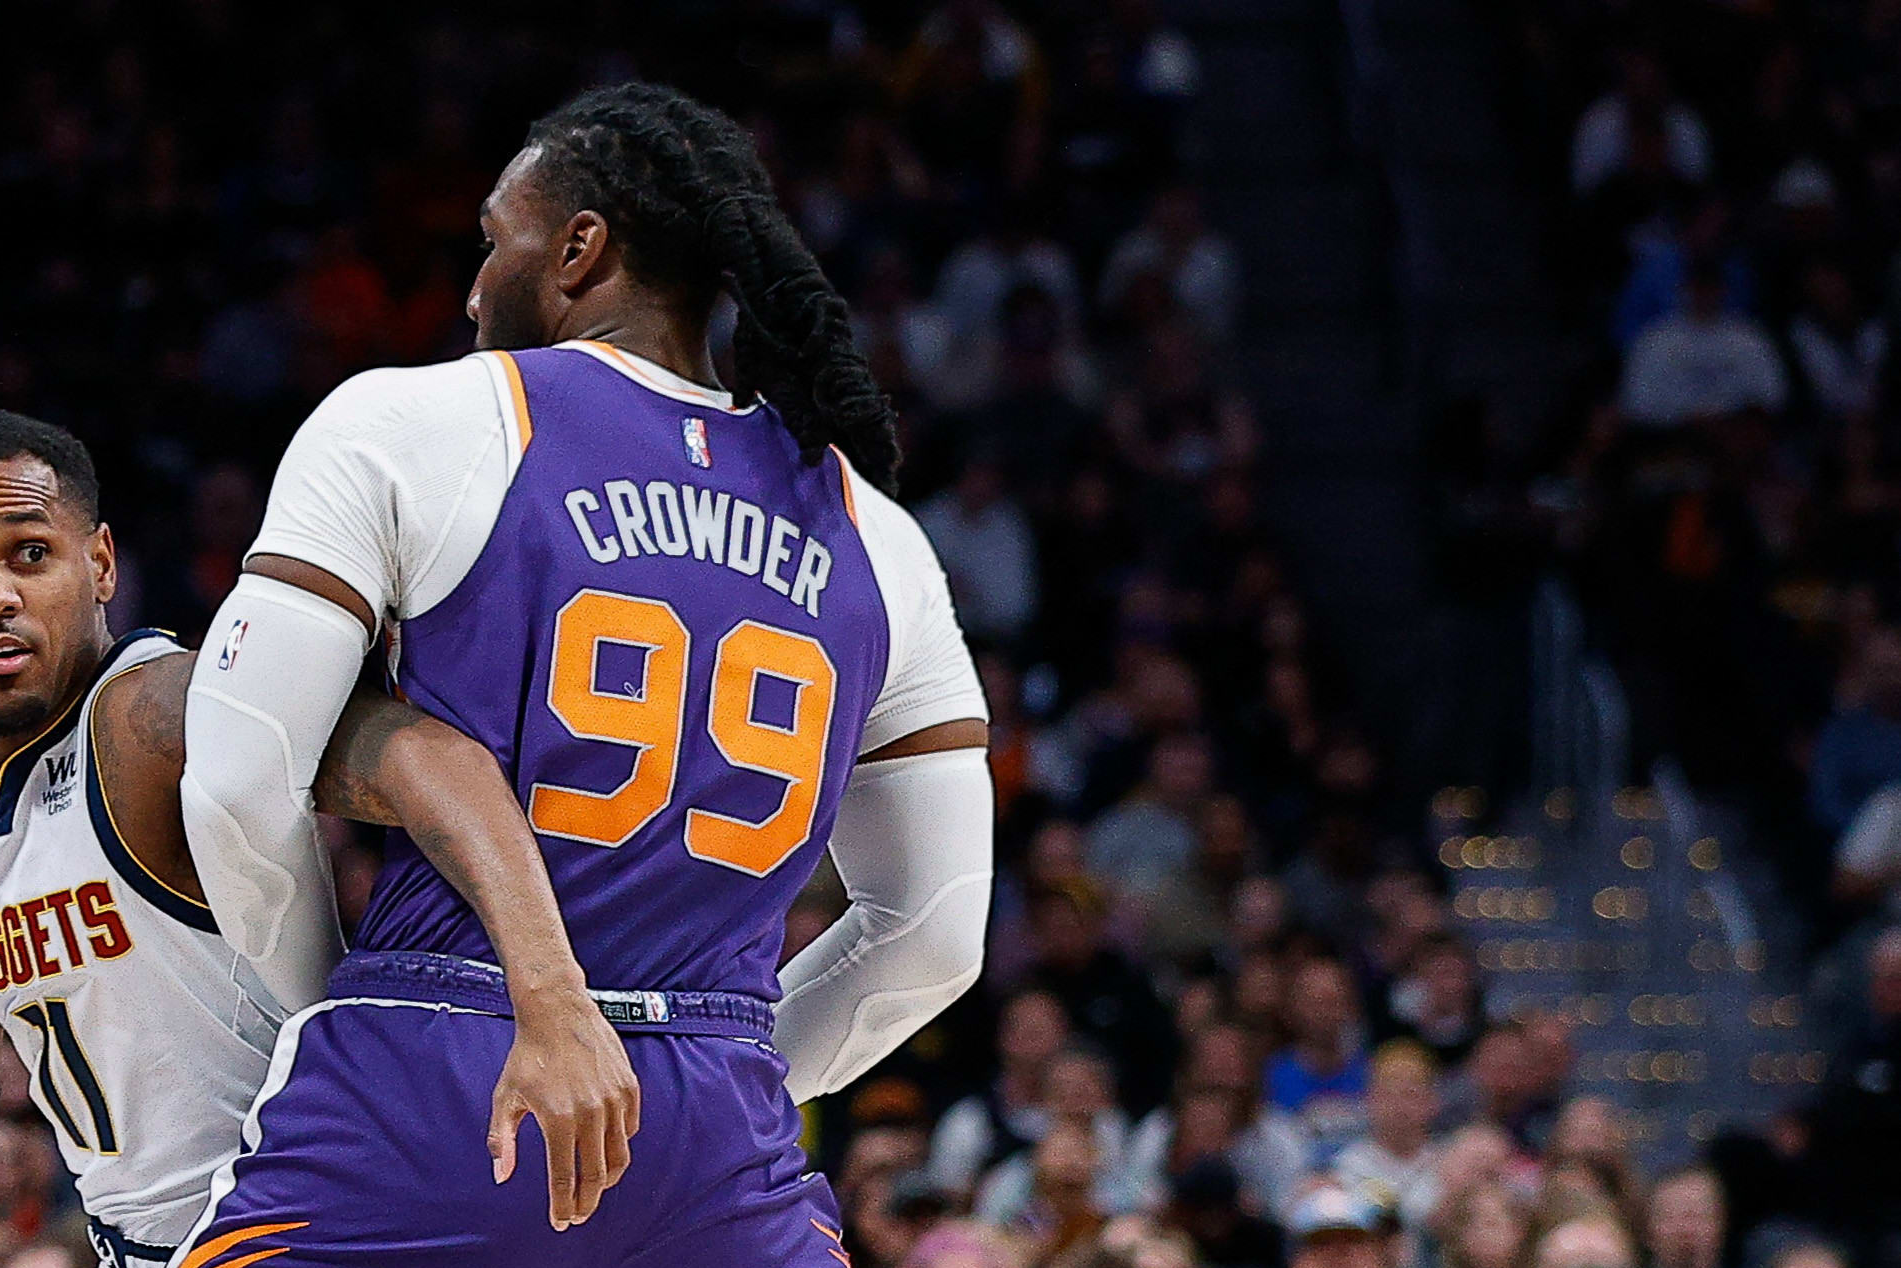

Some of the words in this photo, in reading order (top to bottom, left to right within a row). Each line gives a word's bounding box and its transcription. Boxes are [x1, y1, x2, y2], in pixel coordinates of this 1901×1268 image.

[564, 478, 834, 618] CROWDER
[528, 587, 837, 879] 99
[11, 997, 121, 1156] 11
